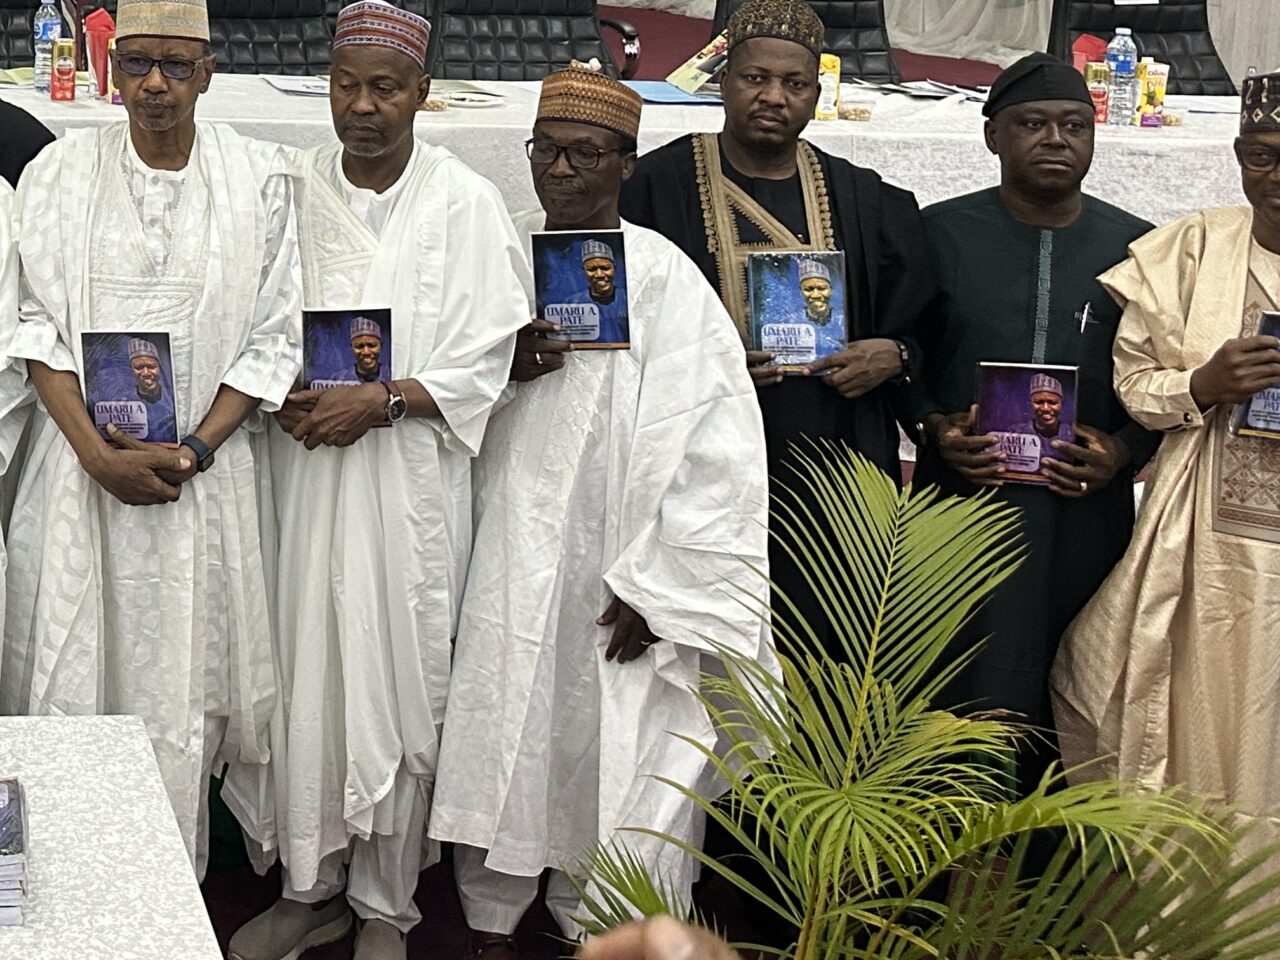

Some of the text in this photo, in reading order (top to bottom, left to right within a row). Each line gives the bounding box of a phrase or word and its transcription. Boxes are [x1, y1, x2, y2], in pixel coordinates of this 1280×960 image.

[547, 307, 597, 316] UMARU A
[96, 404, 144, 414] UMARU A
